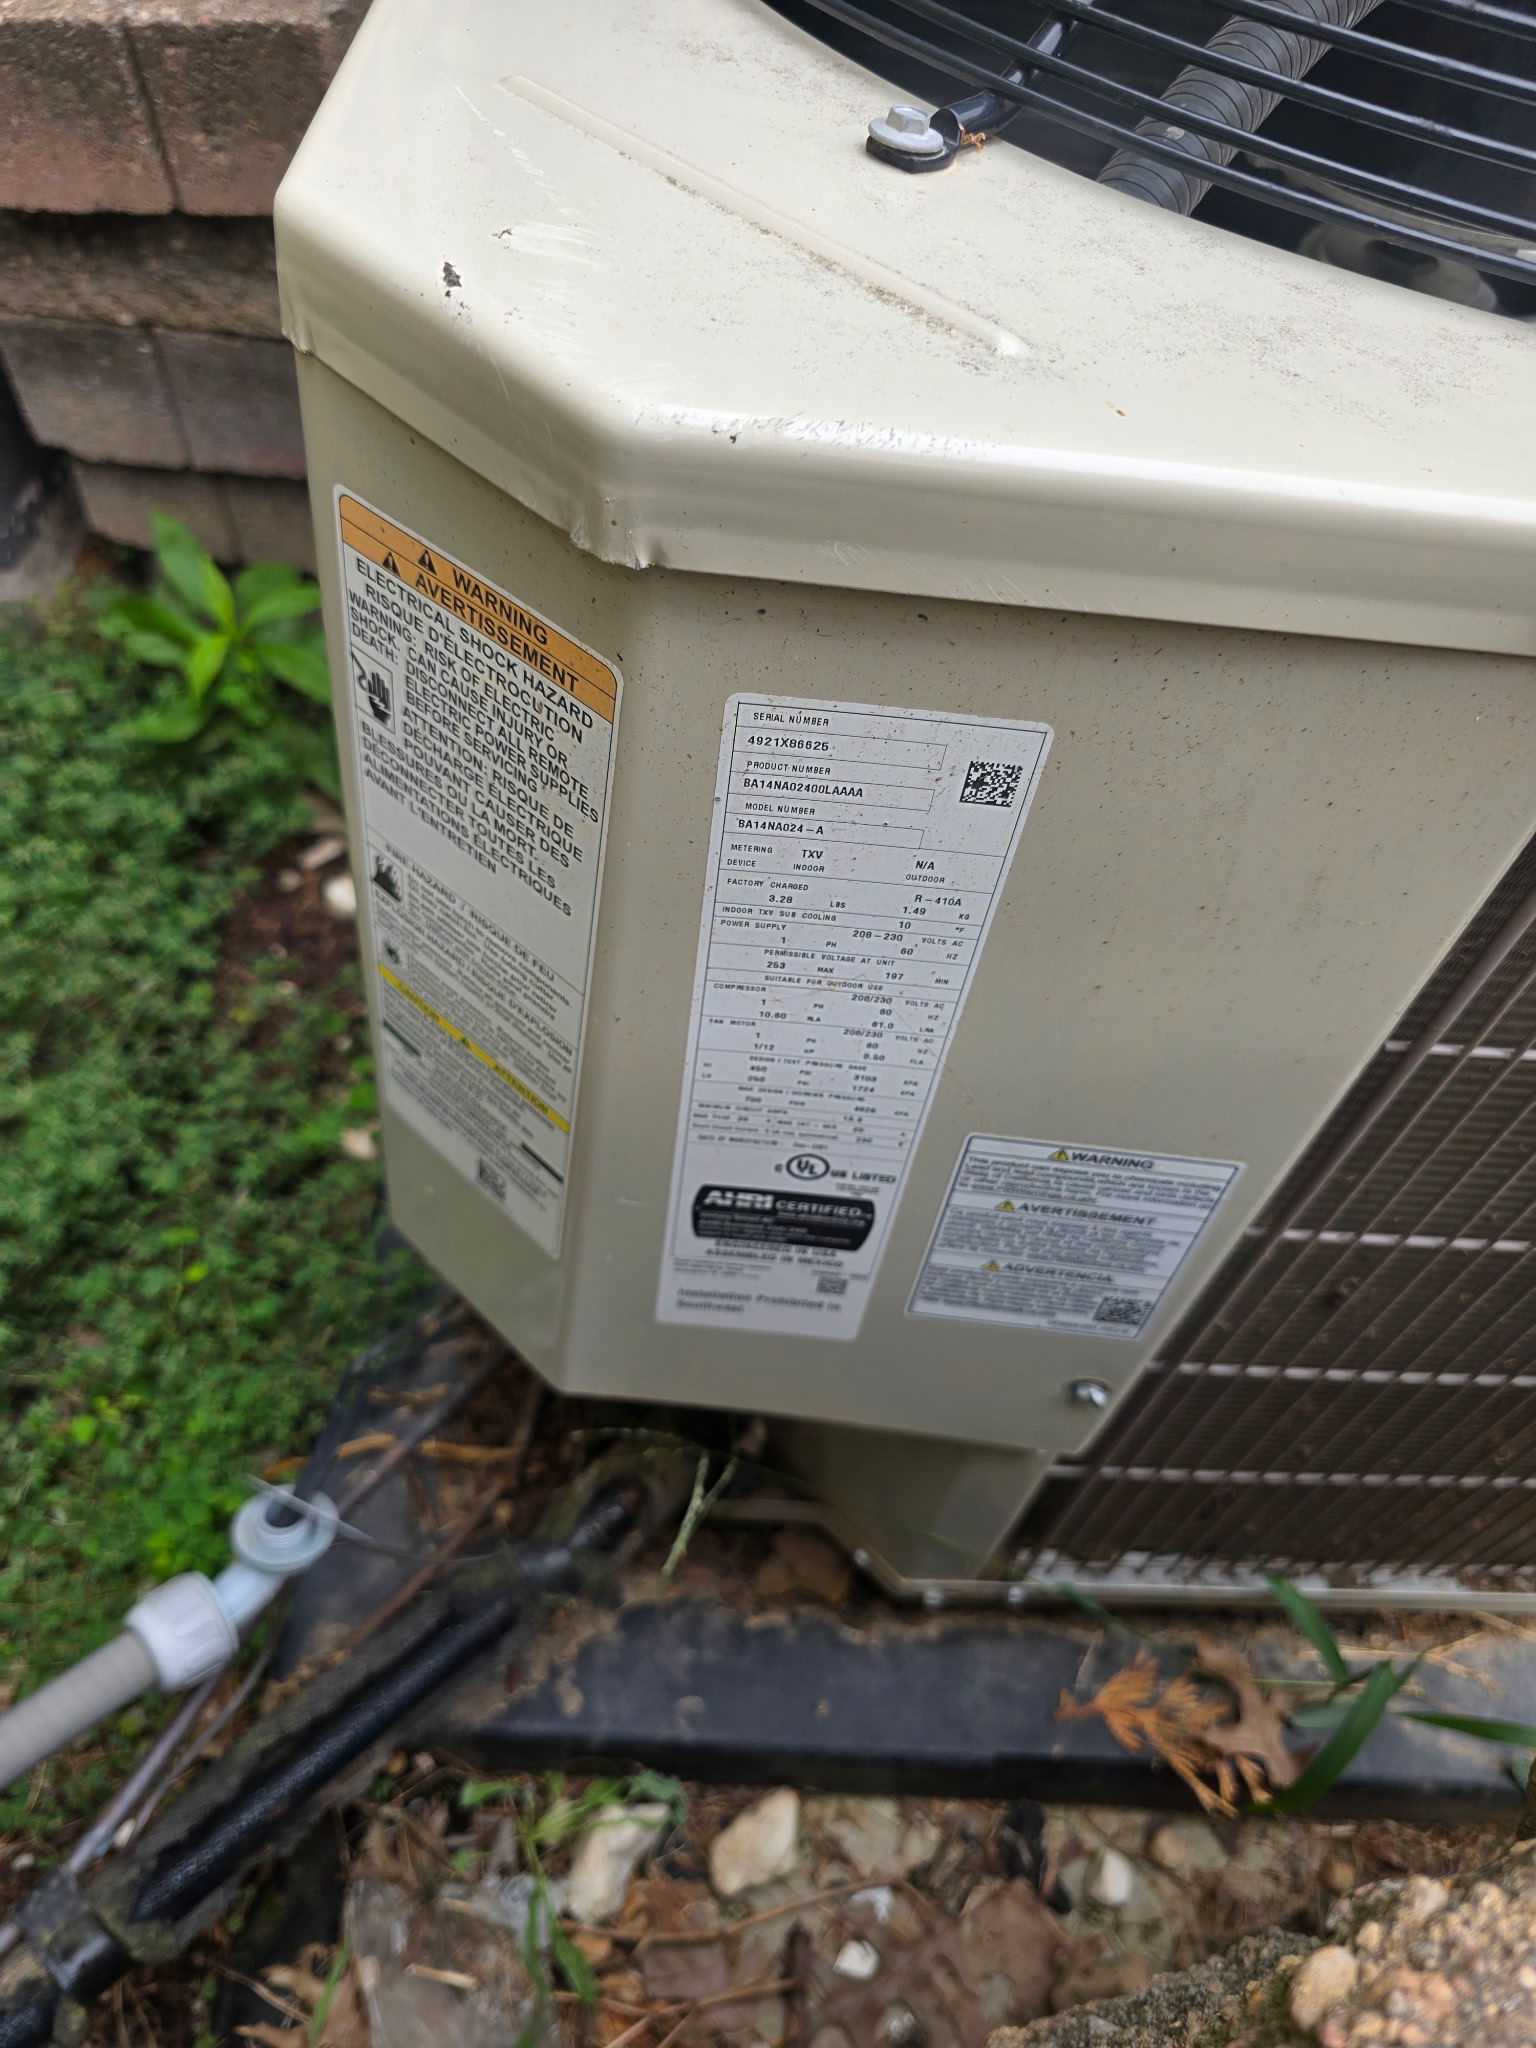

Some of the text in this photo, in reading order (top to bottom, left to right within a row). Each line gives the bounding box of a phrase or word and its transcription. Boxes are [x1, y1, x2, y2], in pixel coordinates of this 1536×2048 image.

[453, 568, 548, 648] WARNING
[356, 557, 593, 731] ELECTRICAL SHOCK HAZARD
[415, 569, 578, 696] AVERTISSEMENT
[349, 589, 554, 742] WARNING: RISK OF ELECTRIC
[365, 582, 583, 744] RISQUE D'ÉLECTROCUTION
[350, 605, 568, 769] SHOCK. CAN CAUSE INJURY OR
[351, 621, 588, 800] DEATH: DISCONNECT ALL REMOTE
[753, 710, 830, 728] SERIAL NUMBER
[405, 674, 599, 824] ELECTRIC POWER SUPPLIES
[406, 689, 537, 793] BEFORE SERVICING
[747, 734, 829, 752] 4921X86625
[402, 703, 574, 839] ATTENTION: RISQUE DE
[746, 758, 831, 776] PRODUCT NUMBER
[361, 720, 538, 861] BLESSURES OU LA MORT.
[403, 718, 583, 863] DÉCHARGE ÉLECTRIQUE
[743, 777, 864, 799] BA14NA02400LAAAA
[362, 733, 555, 889] DÉCONNECTER TOUTES LES
[404, 737, 569, 869] POUVANT CAUSER DES
[744, 800, 816, 816] MODEL NUMBER
[363, 749, 468, 839] ALIMENTATIONS
[473, 830, 572, 917] ÉLECTRIQUES
[364, 765, 496, 874] AVANT L'ENTRETIEN
[726, 857, 945, 884] DEVICE INDOOR OUTDOOR
[730, 842, 936, 871] METERING TXV N/A
[726, 877, 763, 888] FACTORY
[769, 880, 809, 892] CHARGED
[721, 904, 753, 915] INDOOR
[758, 907, 774, 916] TXV
[779, 909, 796, 918] SUB
[801, 911, 837, 922] COOLING
[897, 920, 912, 930] 10
[768, 893, 970, 921] 3.28 LBS 1.49 KG
[411, 861, 455, 905] HAZARD
[470, 908, 510, 948] RISQUE
[514, 943, 529, 962] DE
[532, 957, 554, 982] FEU
[720, 918, 750, 928] POWER
[754, 921, 786, 932] SUPPLY
[920, 936, 947, 946] VOLTS
[951, 939, 964, 947] AC
[763, 947, 816, 960] PERMISSIBLE
[821, 953, 856, 963] VOLTAGE
[875, 958, 895, 966] UNIT
[825, 940, 837, 948] PH
[899, 947, 914, 956] 60
[945, 952, 958, 960] HZ
[764, 973, 883, 991] SUITABLE FOR OUTDOOR USE
[766, 960, 786, 969] 253
[816, 965, 834, 973] MAX
[884, 971, 904, 981] 197
[713, 982, 766, 993] COMPRESSOR
[904, 999, 929, 1008] VOLTS
[1069, 1151, 1156, 1169] WARNING
[851, 1171, 897, 1184] LISTED
[774, 1199, 862, 1217] CERTIFIED
[1016, 1202, 1156, 1226] AVERTISSEMENT
[1002, 1262, 1115, 1283] ADVERTENCIA
